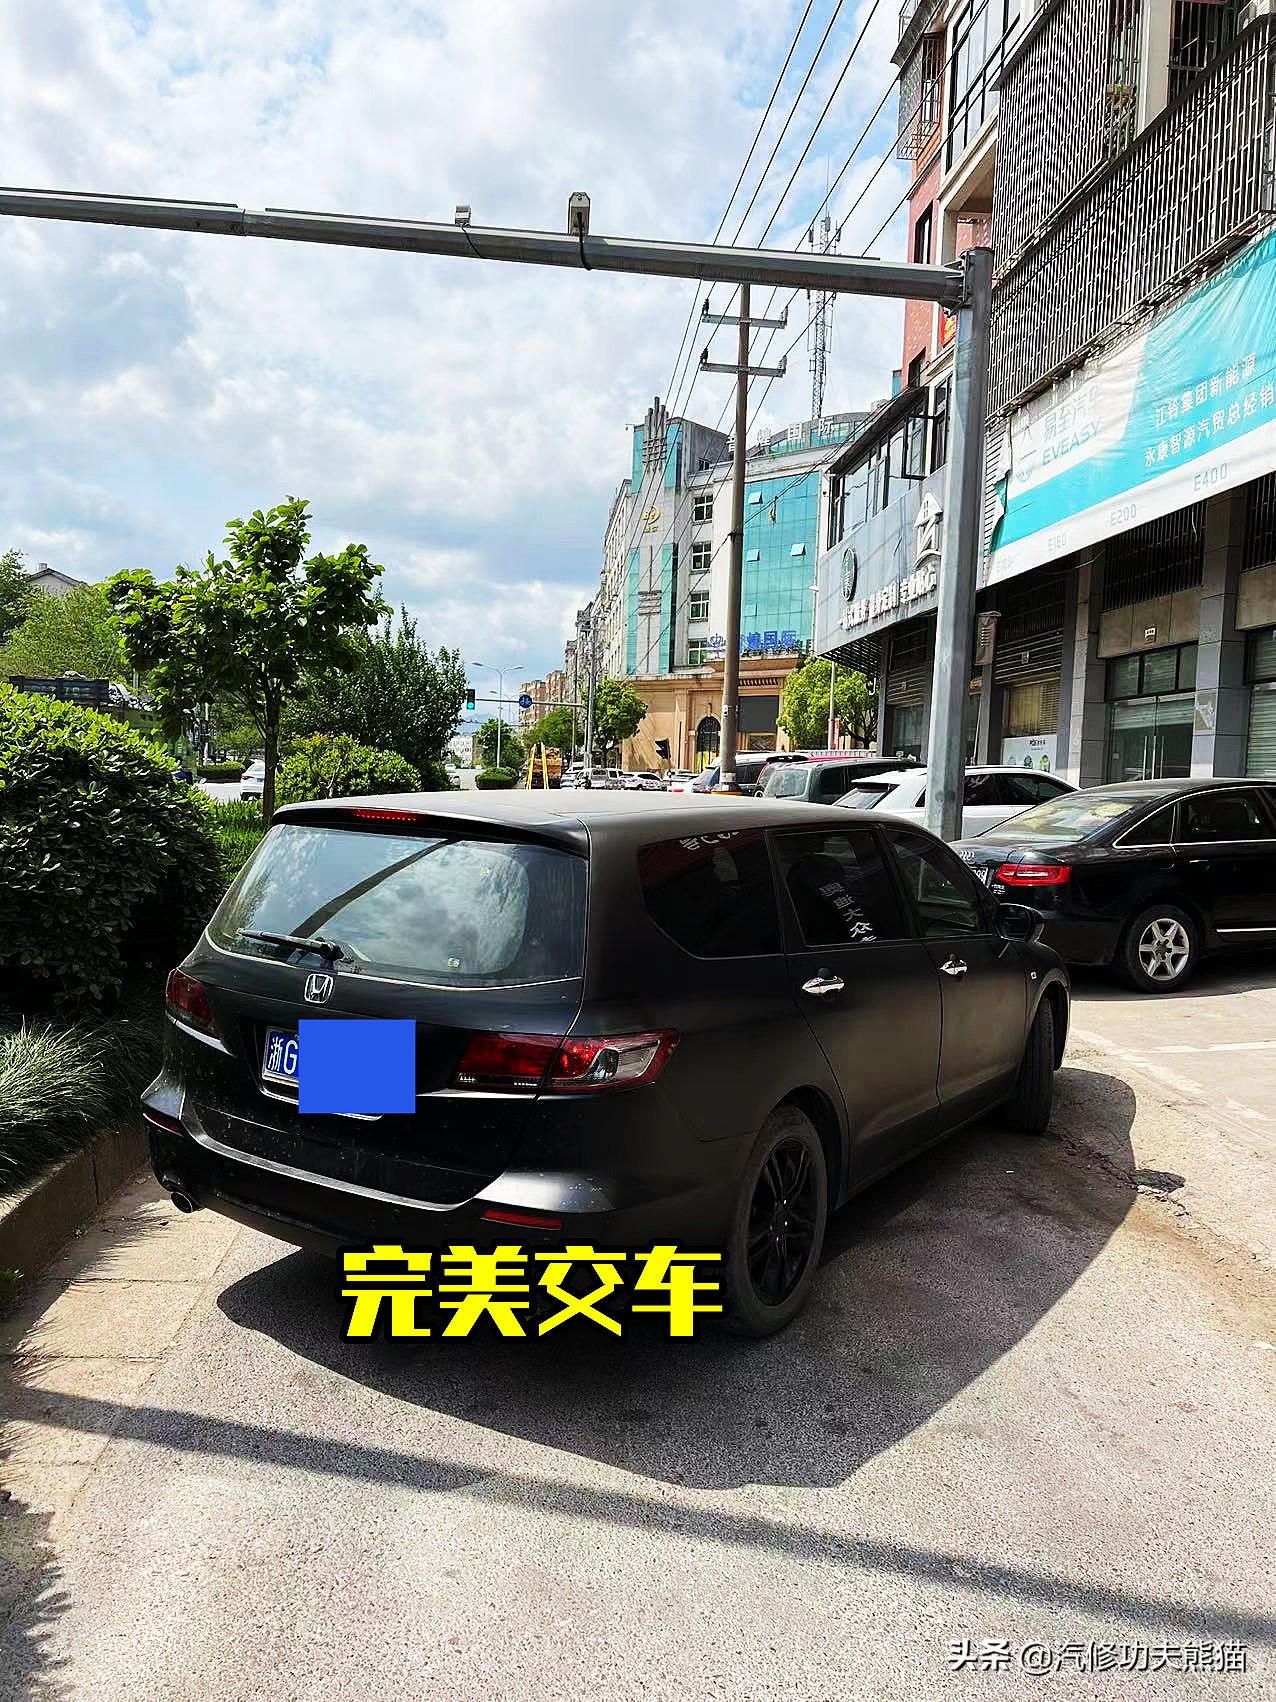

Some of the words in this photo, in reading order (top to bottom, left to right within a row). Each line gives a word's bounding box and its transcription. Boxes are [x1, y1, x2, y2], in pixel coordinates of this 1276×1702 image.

[1043, 417, 1101, 466] EVEASY
[1194, 462, 1228, 493] E400
[1110, 503, 1137, 526] E200
